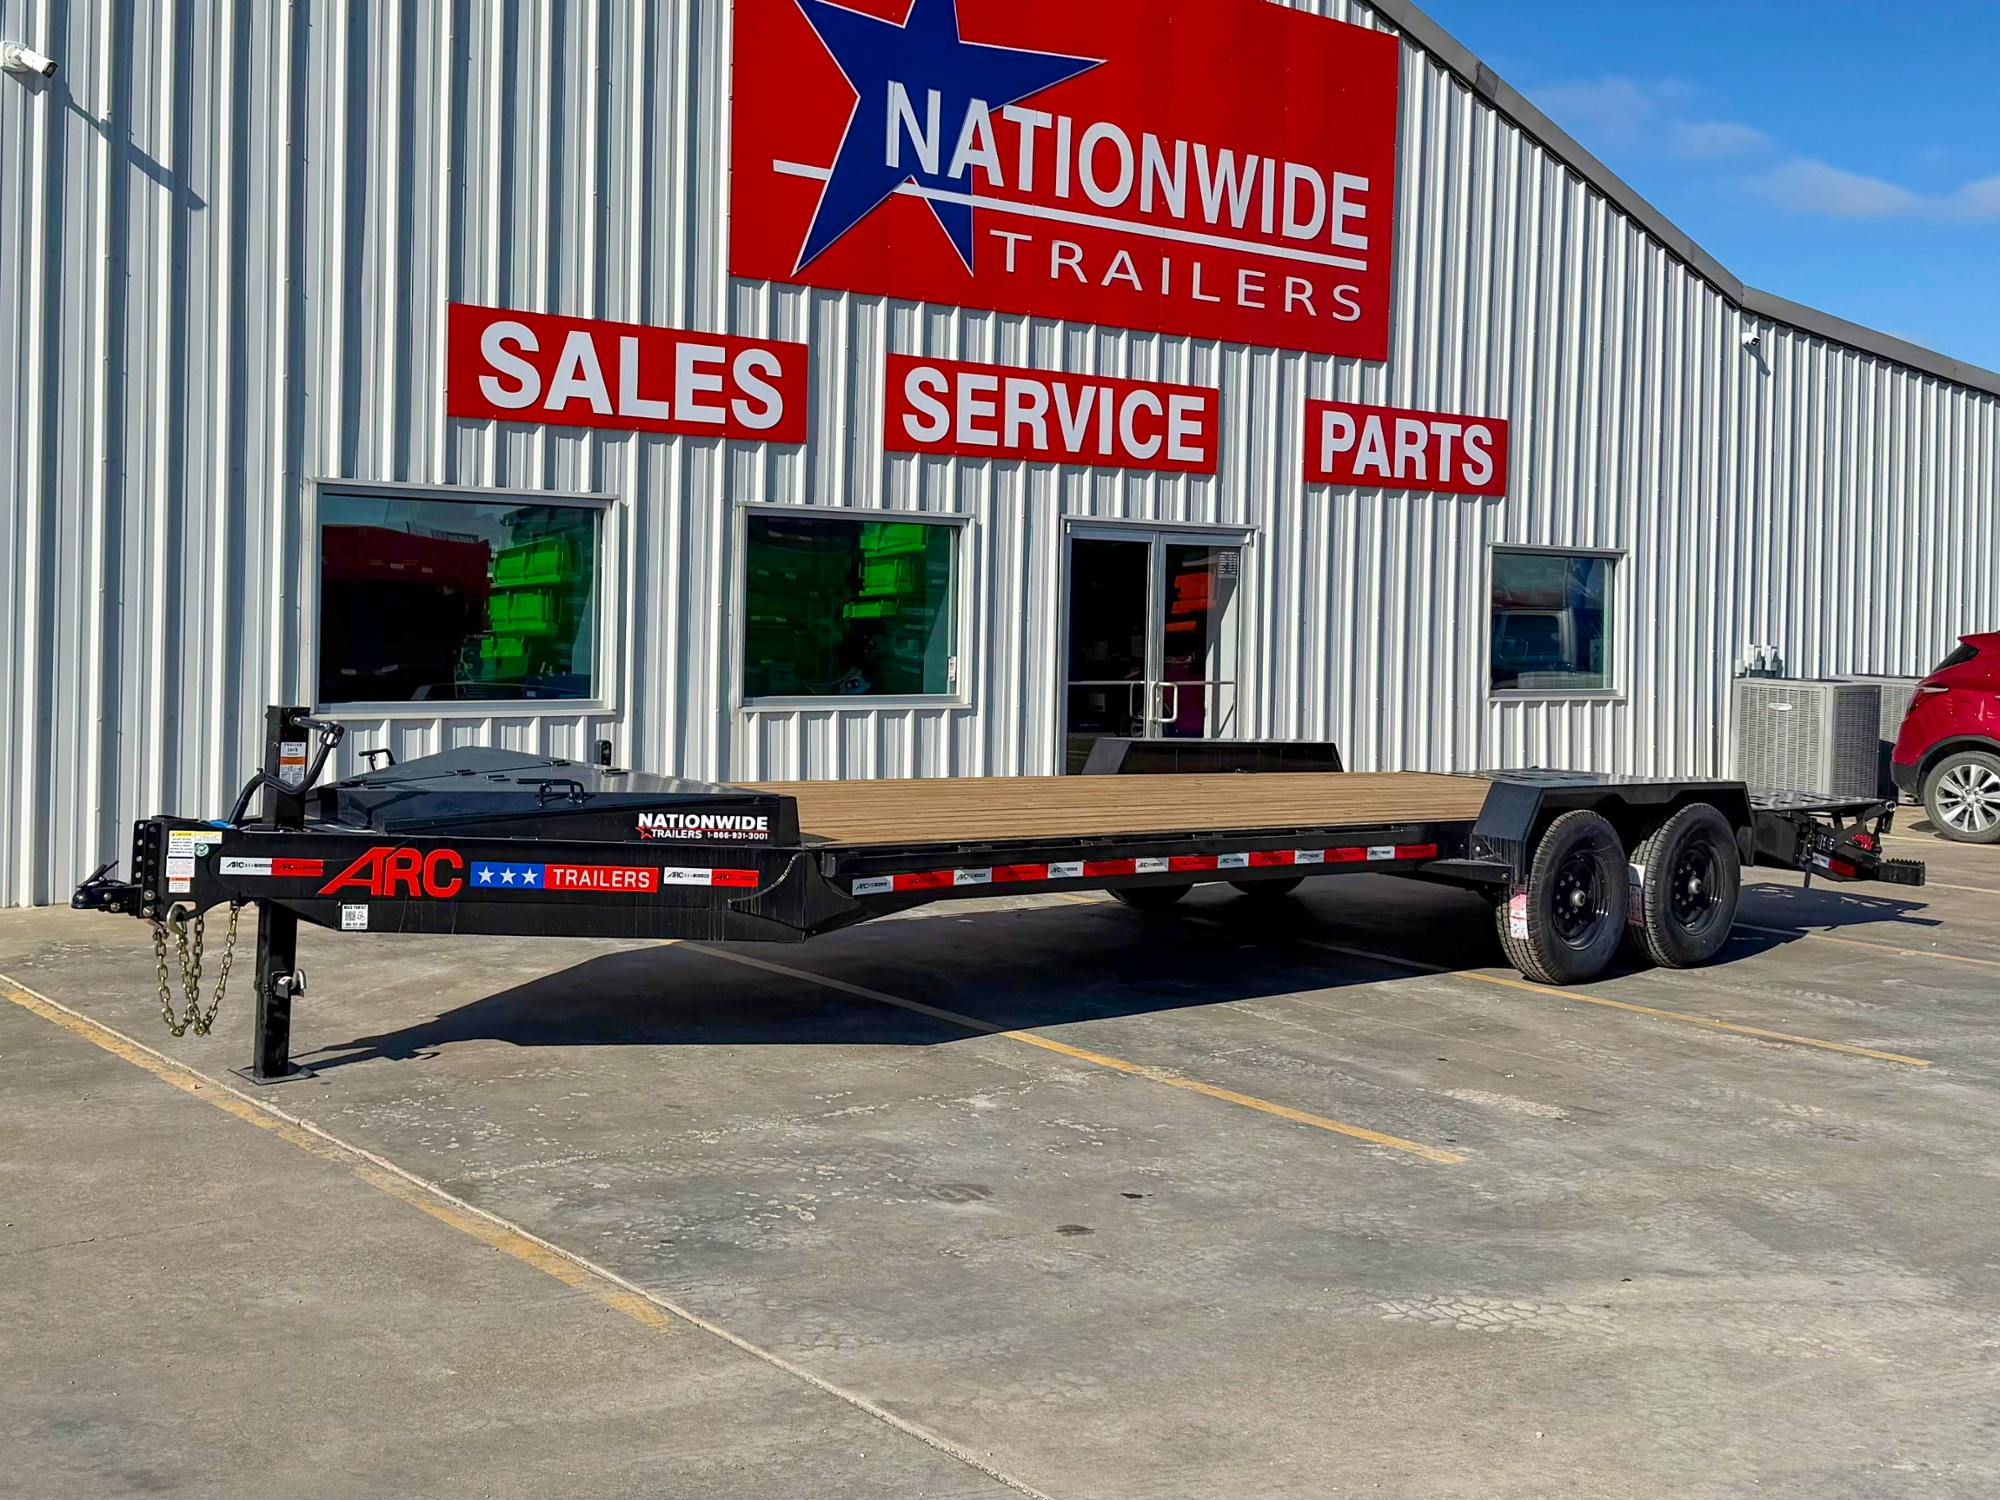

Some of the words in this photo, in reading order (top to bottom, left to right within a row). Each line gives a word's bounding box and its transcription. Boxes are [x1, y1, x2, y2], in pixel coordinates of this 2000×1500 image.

[886, 80, 1369, 250] NATIONWIDE
[989, 229, 1361, 322] TRAILERS
[478, 321, 784, 429] SALES
[903, 366, 1205, 462] SERVICE
[1320, 410, 1494, 486] PARTS
[638, 813, 768, 830] NATIONWIDE
[651, 829, 702, 839] TRAILERS
[316, 847, 464, 898] ARC
[552, 868, 650, 888] TRAILERS
